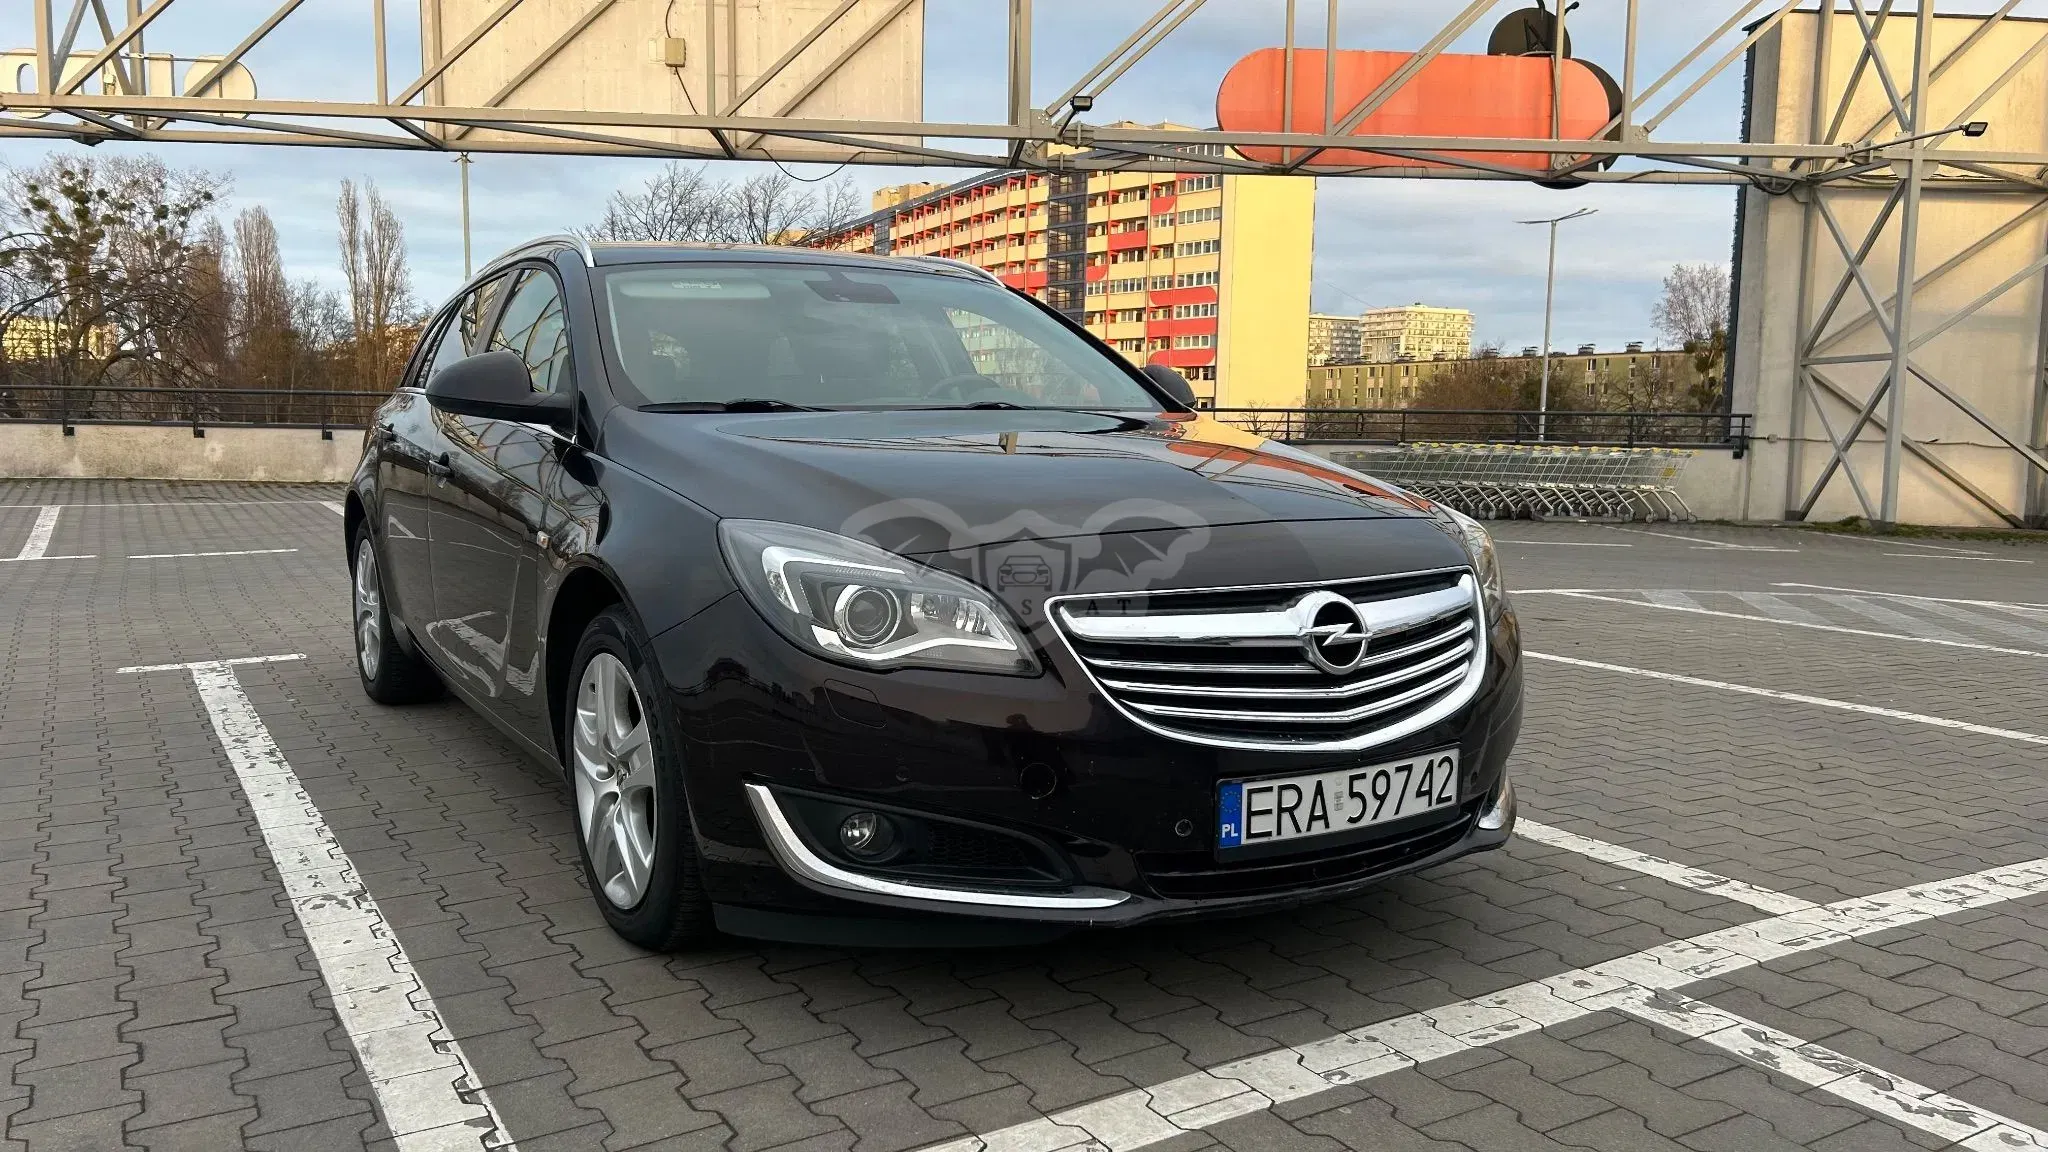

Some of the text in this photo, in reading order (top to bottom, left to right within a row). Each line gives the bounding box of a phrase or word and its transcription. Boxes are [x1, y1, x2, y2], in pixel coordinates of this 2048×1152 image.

[1245, 755, 1455, 840] ERA 59742
[1221, 822, 1239, 839] PL
